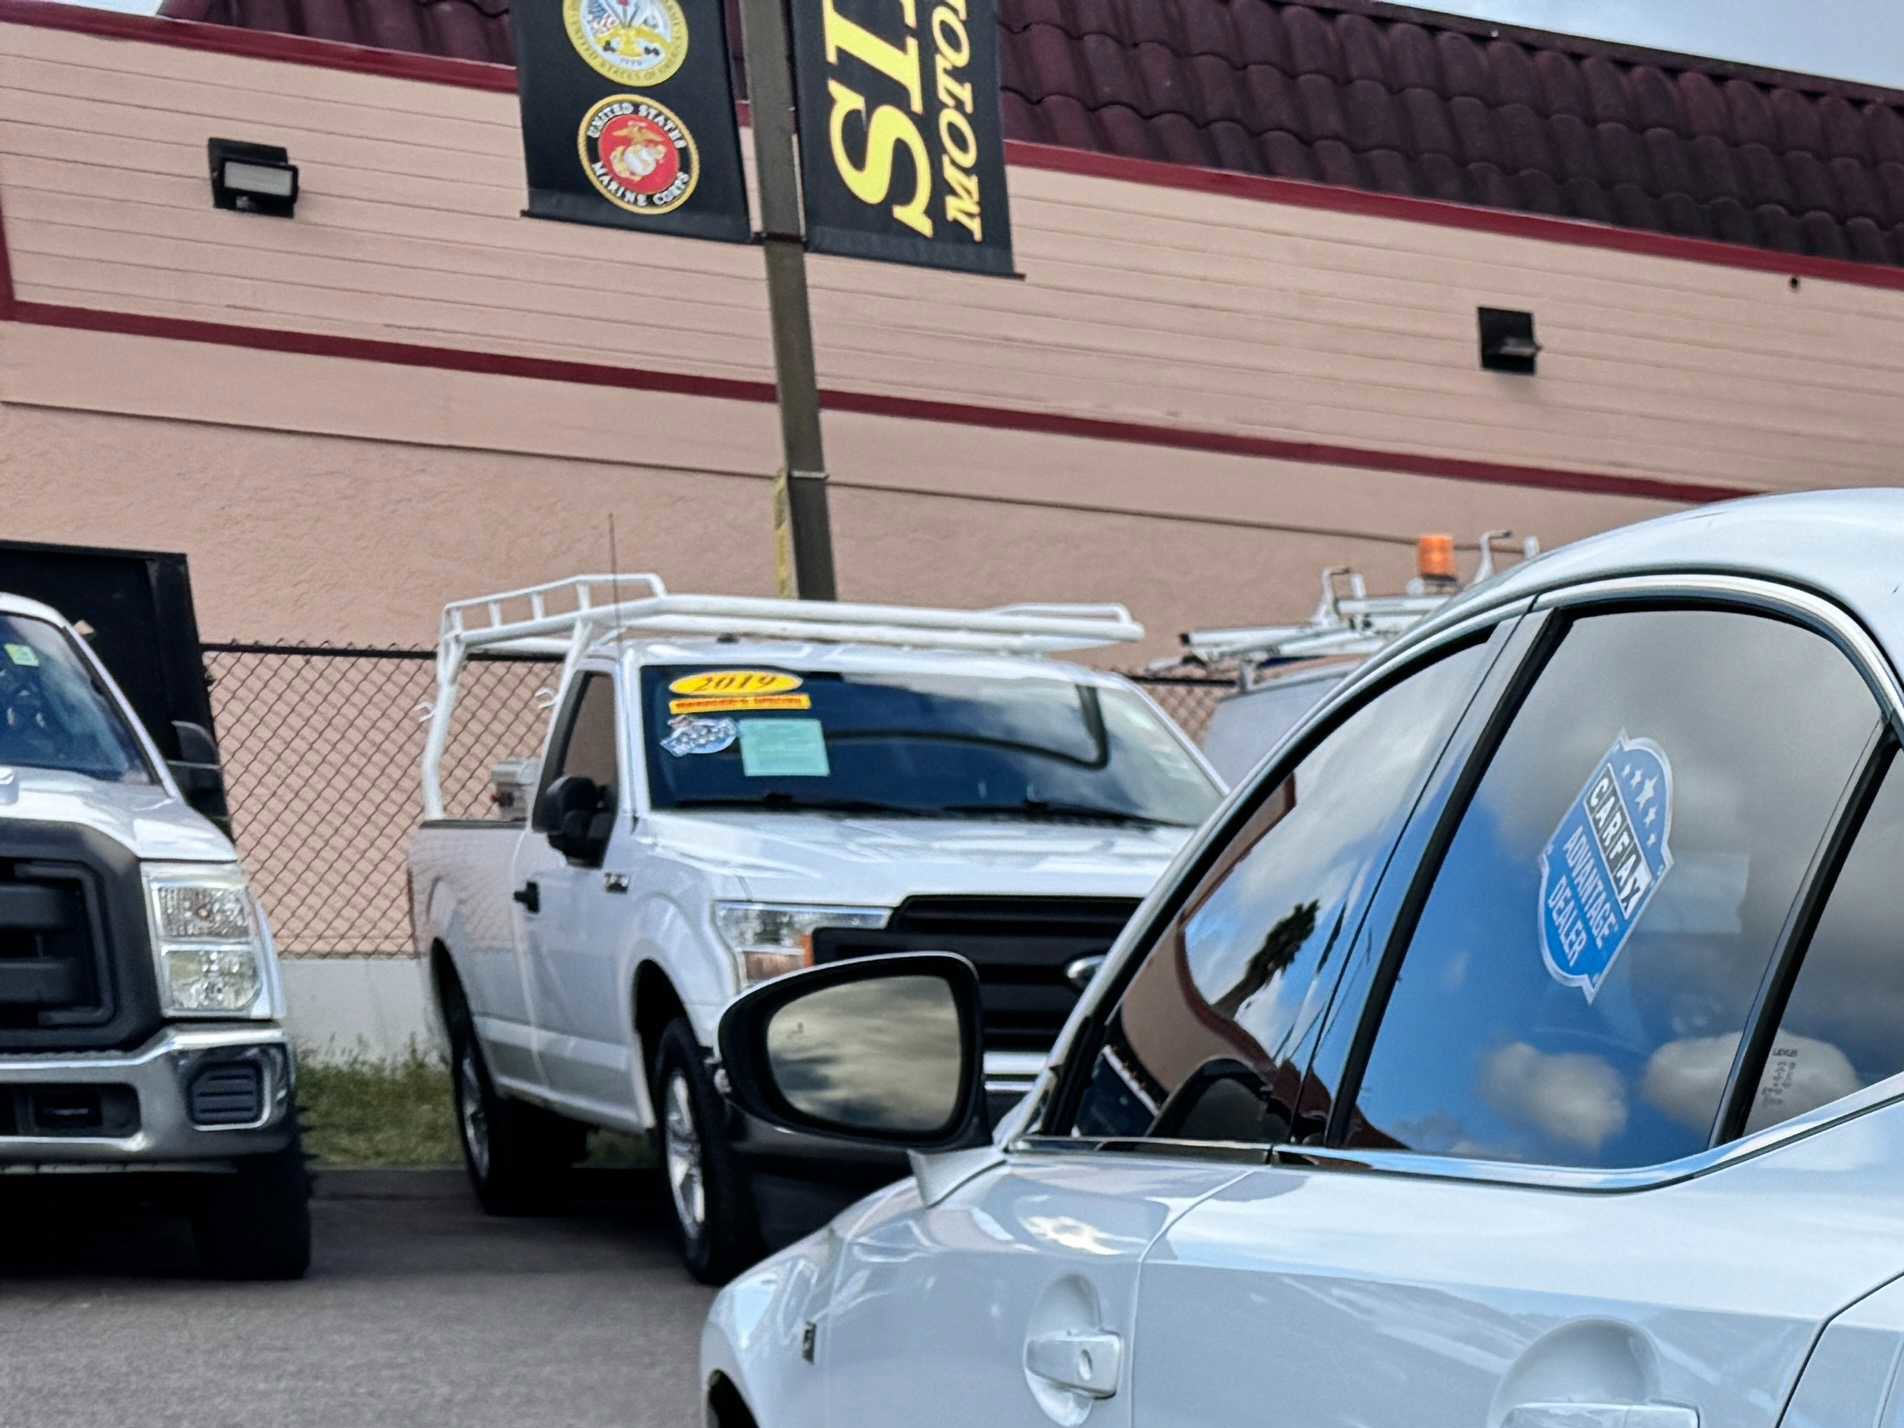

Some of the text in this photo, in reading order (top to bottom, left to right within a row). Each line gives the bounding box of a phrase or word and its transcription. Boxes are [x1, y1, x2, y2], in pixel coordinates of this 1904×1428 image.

[587, 102, 688, 149] UNITED STATES
[931, 0, 983, 243] MOTO
[592, 161, 690, 206] MARINE CORPS
[693, 674, 777, 692] 2019
[1562, 824, 1619, 950] ADVANTAGE
[1589, 775, 1645, 913] CARFAX
[1548, 874, 1588, 968] DEALER
